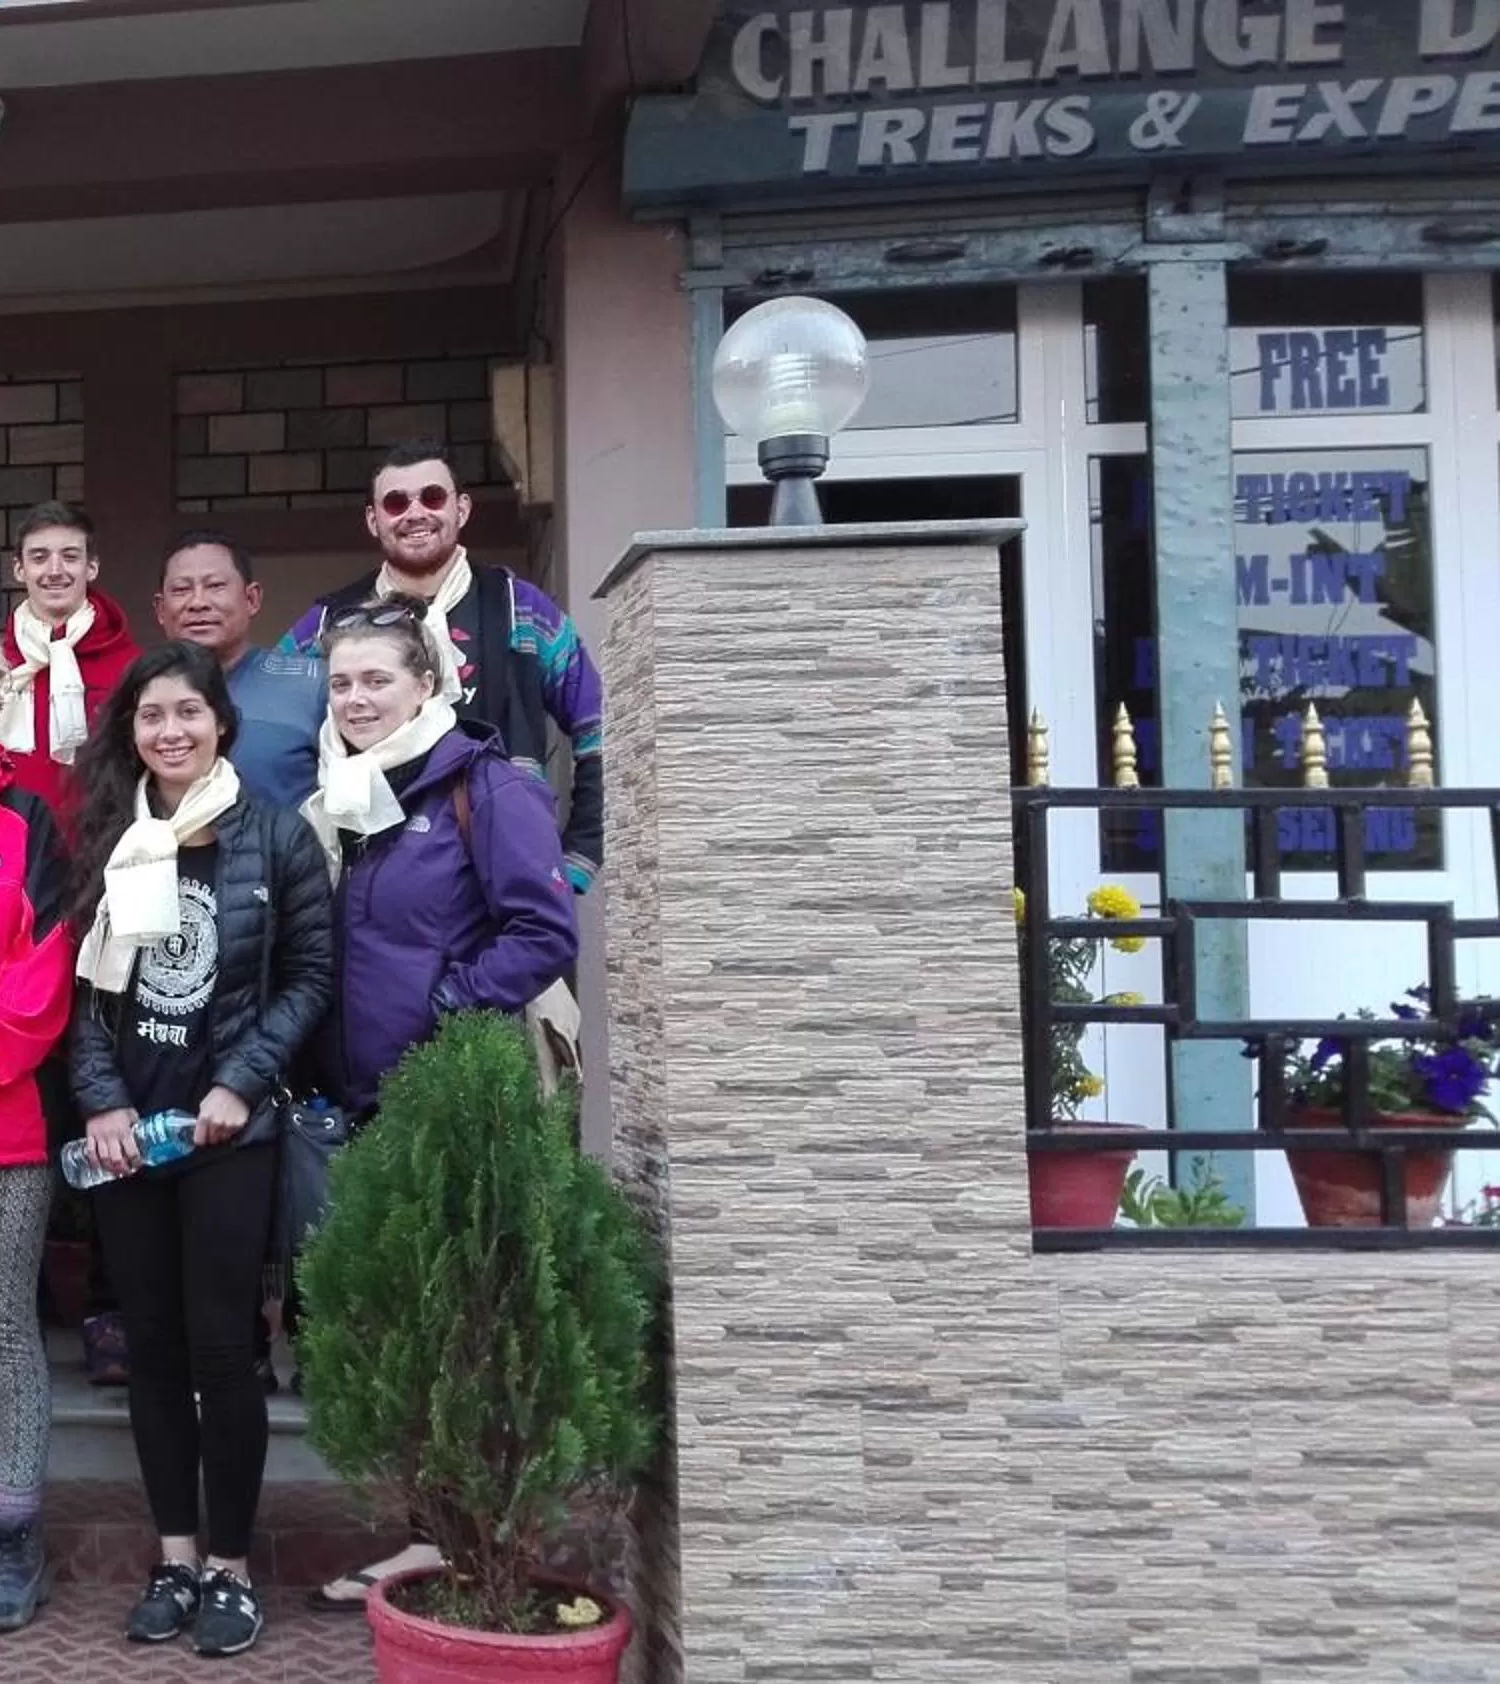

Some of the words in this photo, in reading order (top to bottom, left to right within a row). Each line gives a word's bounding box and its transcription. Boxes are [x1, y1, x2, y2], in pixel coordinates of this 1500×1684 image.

[731, 0, 1345, 101] CHALLANGE
[787, 95, 1096, 174] TREKS
[1129, 89, 1202, 149] &
[1242, 70, 1500, 145] EXPE
[1257, 328, 1391, 411] FREE
[1235, 471, 1409, 524] TICKET
[1247, 634, 1417, 688] TICKET
[1274, 716, 1412, 769] TCKET
